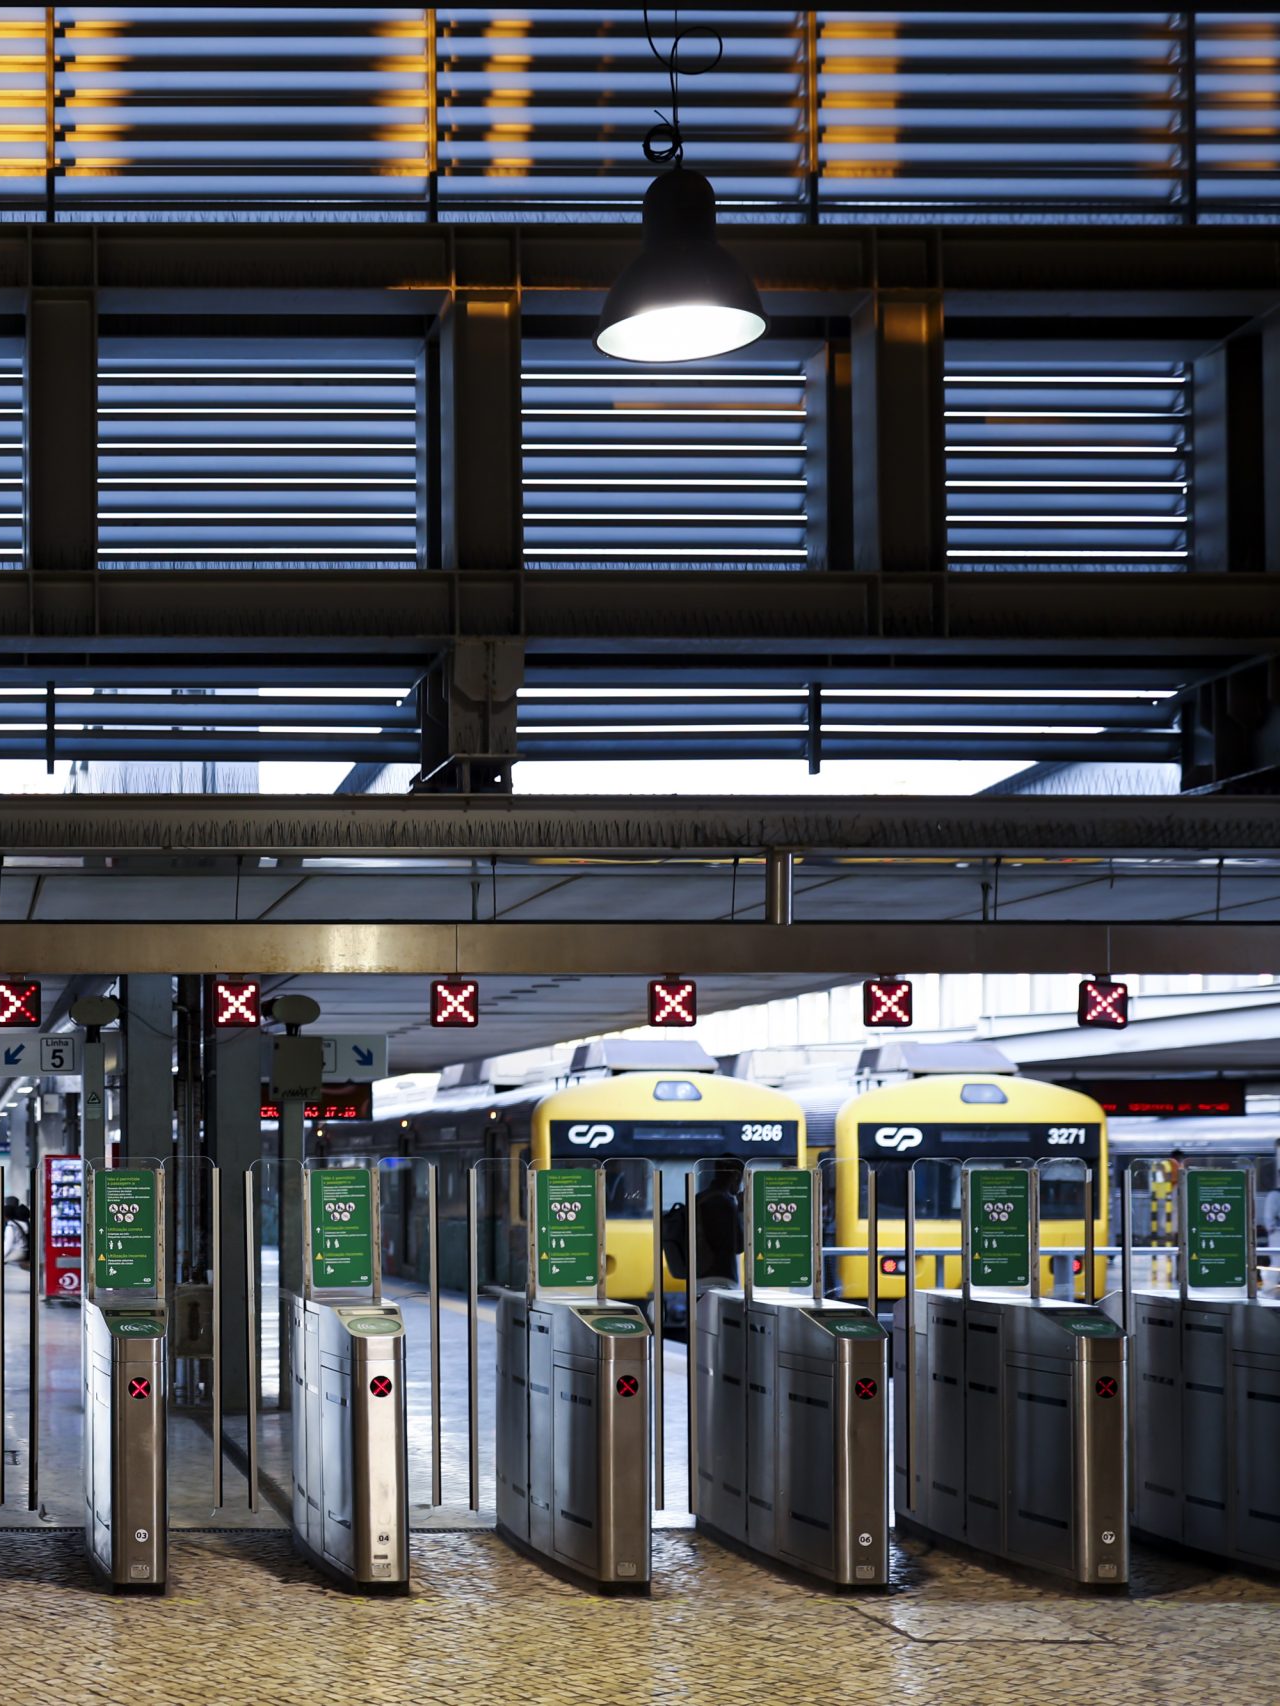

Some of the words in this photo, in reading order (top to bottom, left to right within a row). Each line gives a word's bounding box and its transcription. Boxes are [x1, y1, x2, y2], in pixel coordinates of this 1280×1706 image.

[45, 1039, 69, 1047] Linha
[51, 1049, 64, 1068] 5
[568, 1125, 614, 1148] CP
[741, 1124, 783, 1141] 3266
[875, 1127, 923, 1151] CP
[1047, 1128, 1085, 1144] 3271
[136, 1531, 147, 1539] 03
[1102, 1533, 1114, 1541] 07
